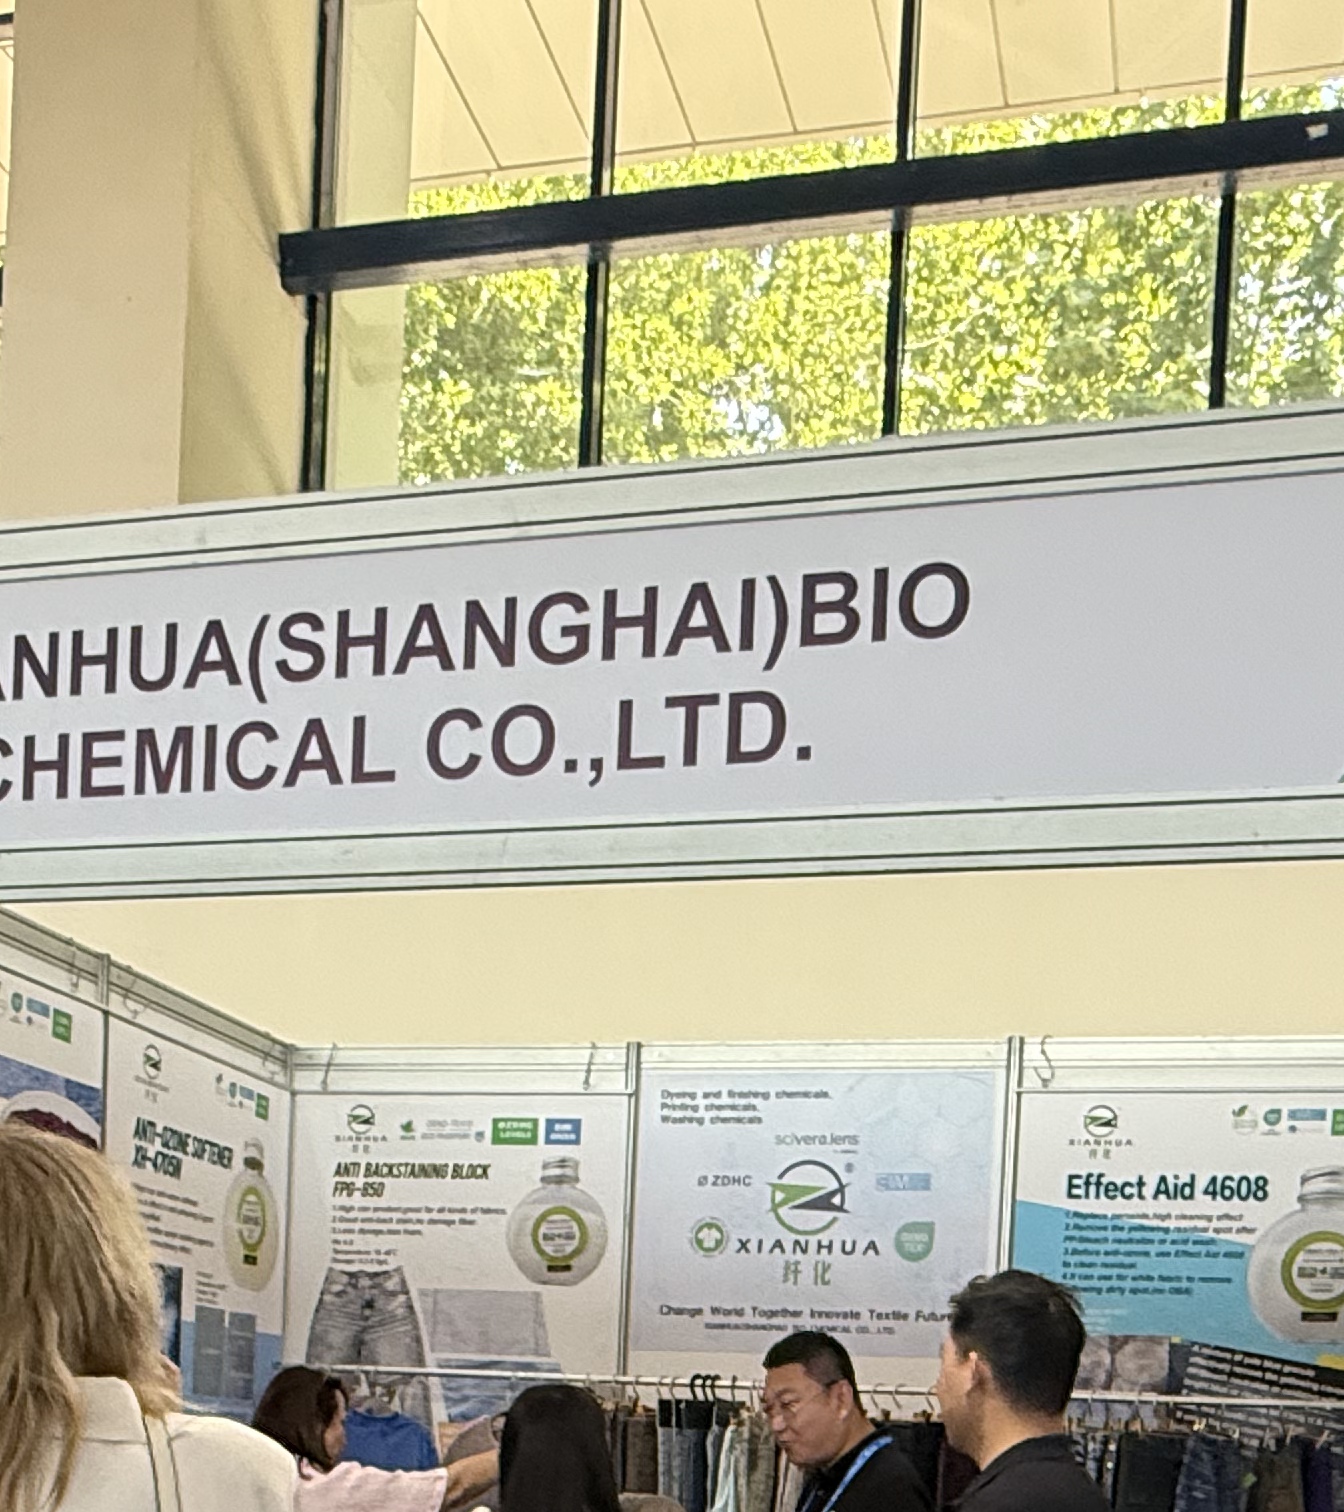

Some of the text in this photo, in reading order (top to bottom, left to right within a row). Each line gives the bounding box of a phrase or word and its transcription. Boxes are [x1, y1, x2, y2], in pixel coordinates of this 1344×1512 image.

[424, 689, 814, 792] CO.,LTD.
[703, 1089, 722, 1100] and
[333, 1161, 492, 1181] ANTI BACKSTAINING BLOCK
[1066, 1172, 1270, 1202] Effect Aid 4608
[734, 1237, 881, 1257] XIANHUA
[659, 1304, 704, 1318] Change
[710, 1305, 745, 1318] World
[751, 1305, 804, 1320] Together
[809, 1307, 862, 1321] Innovate
[867, 1308, 910, 1321] Textile
